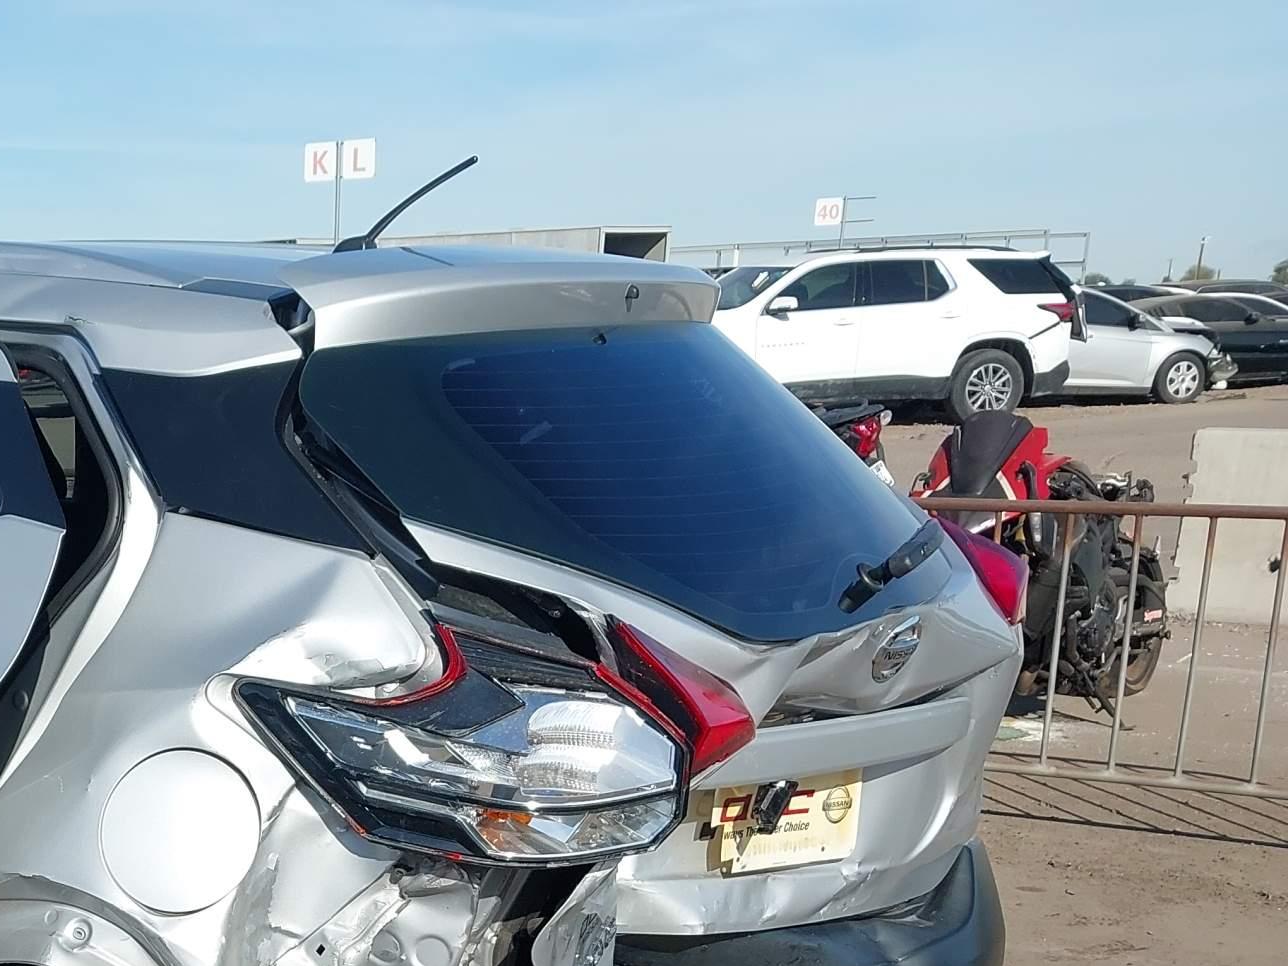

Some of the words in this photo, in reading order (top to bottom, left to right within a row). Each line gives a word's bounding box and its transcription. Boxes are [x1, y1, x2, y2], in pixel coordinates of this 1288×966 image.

[312, 149, 328, 176] K
[352, 147, 367, 172] L
[818, 203, 840, 220] 40
[825, 800, 849, 808] NISSAN
[783, 820, 810, 832] Choice
